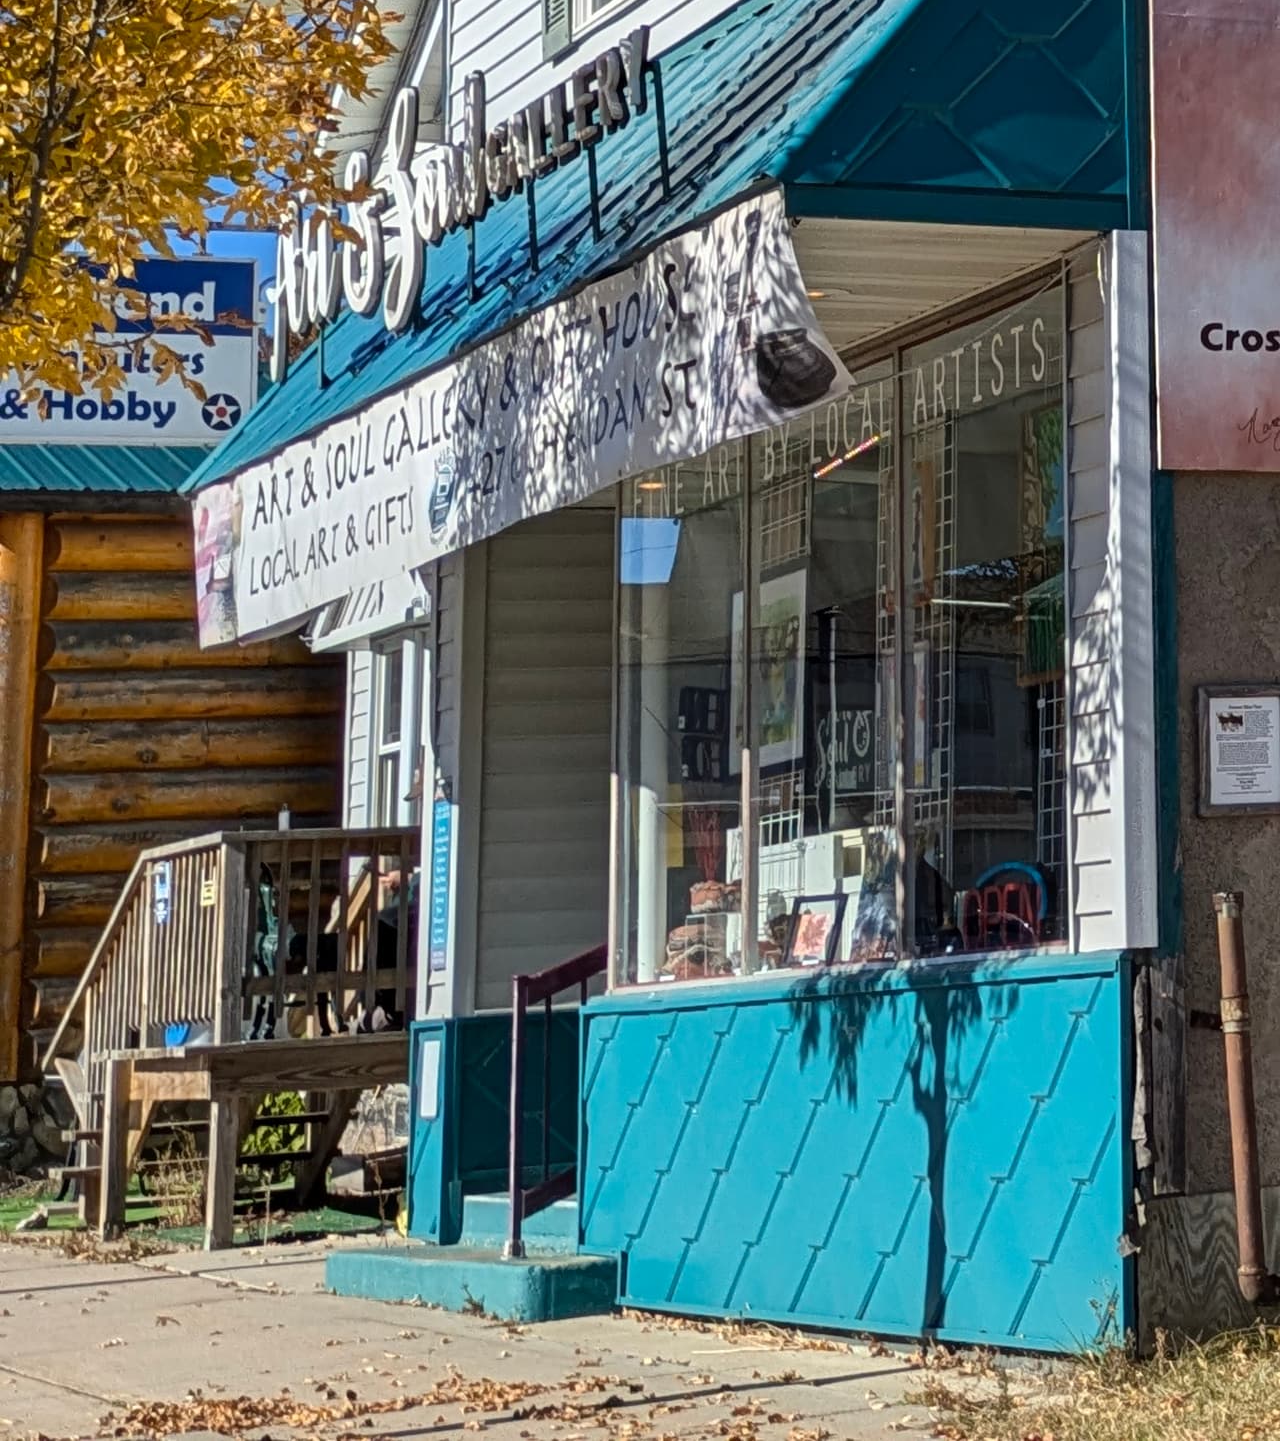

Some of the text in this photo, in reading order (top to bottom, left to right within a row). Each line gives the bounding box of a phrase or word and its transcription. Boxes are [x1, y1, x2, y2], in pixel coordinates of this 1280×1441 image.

[486, 25, 650, 196] GALLERY
[0, 389, 176, 428] & Hobby
[252, 468, 294, 531] ART
[301, 456, 317, 508] &
[326, 424, 375, 499] SOUL
[383, 365, 490, 471] GALLERY
[501, 352, 518, 411] &
[633, 317, 1046, 519] FINE ART BY LOCAL ARTISTS
[661, 359, 697, 418] ST
[250, 485, 413, 596] LOCAL ART & GIFTS
